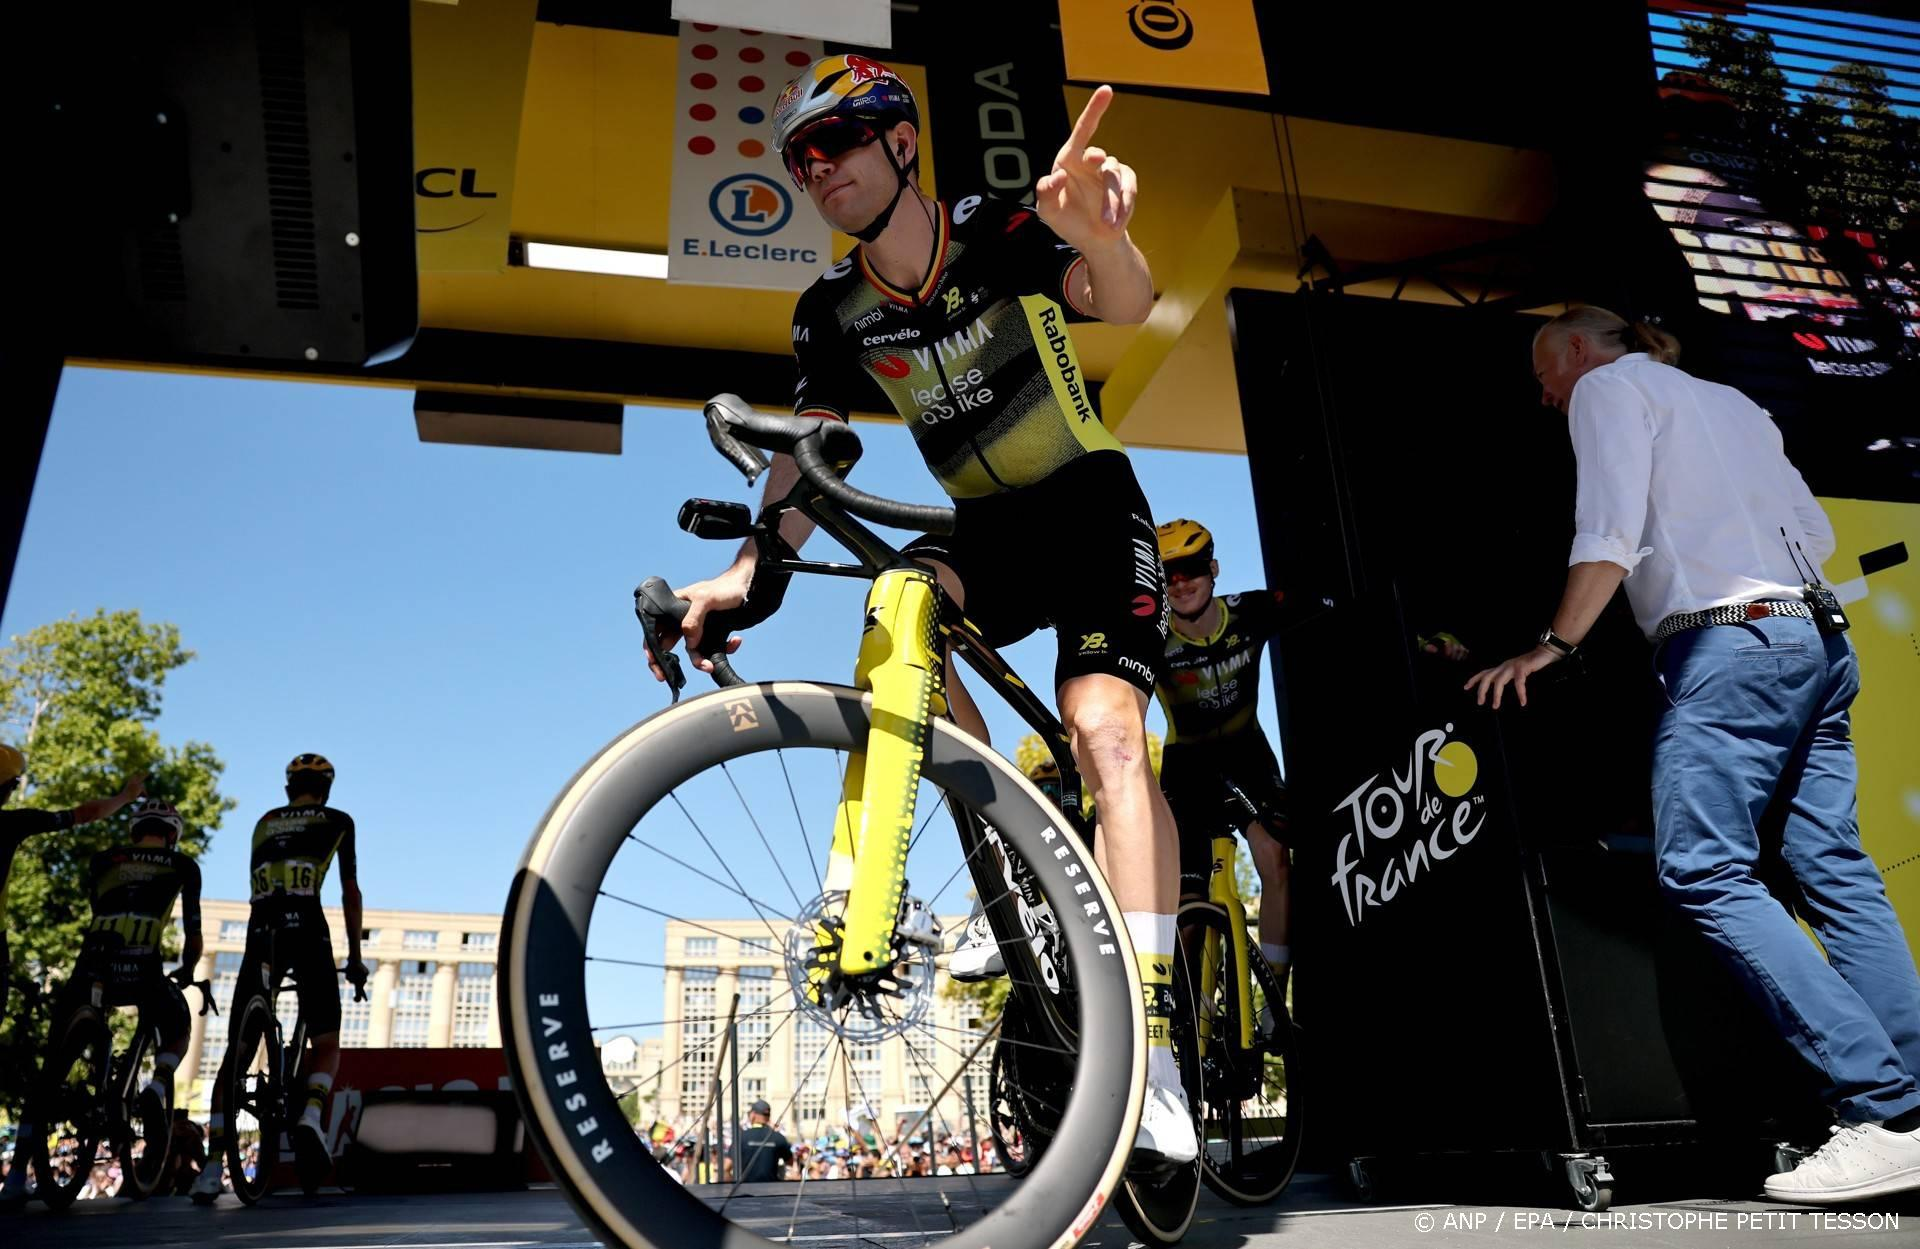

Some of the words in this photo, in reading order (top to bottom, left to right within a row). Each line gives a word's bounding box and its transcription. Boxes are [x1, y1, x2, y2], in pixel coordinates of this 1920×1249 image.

[974, 62, 1034, 205] ODA
[683, 239, 817, 263] E.Leclerc
[854, 308, 884, 332] nimbl
[863, 328, 920, 346] cervélo
[912, 317, 994, 371] VISMA
[1038, 306, 1092, 423] Rabobank
[1132, 538, 1157, 592] VISMA
[1118, 656, 1155, 685] nimbl
[1202, 650, 1250, 680] VISMA
[1420, 792, 1442, 825] de
[291, 866, 311, 889] 16
[1040, 826, 1116, 955] RESERVE
[539, 993, 613, 1164] RESERVE
